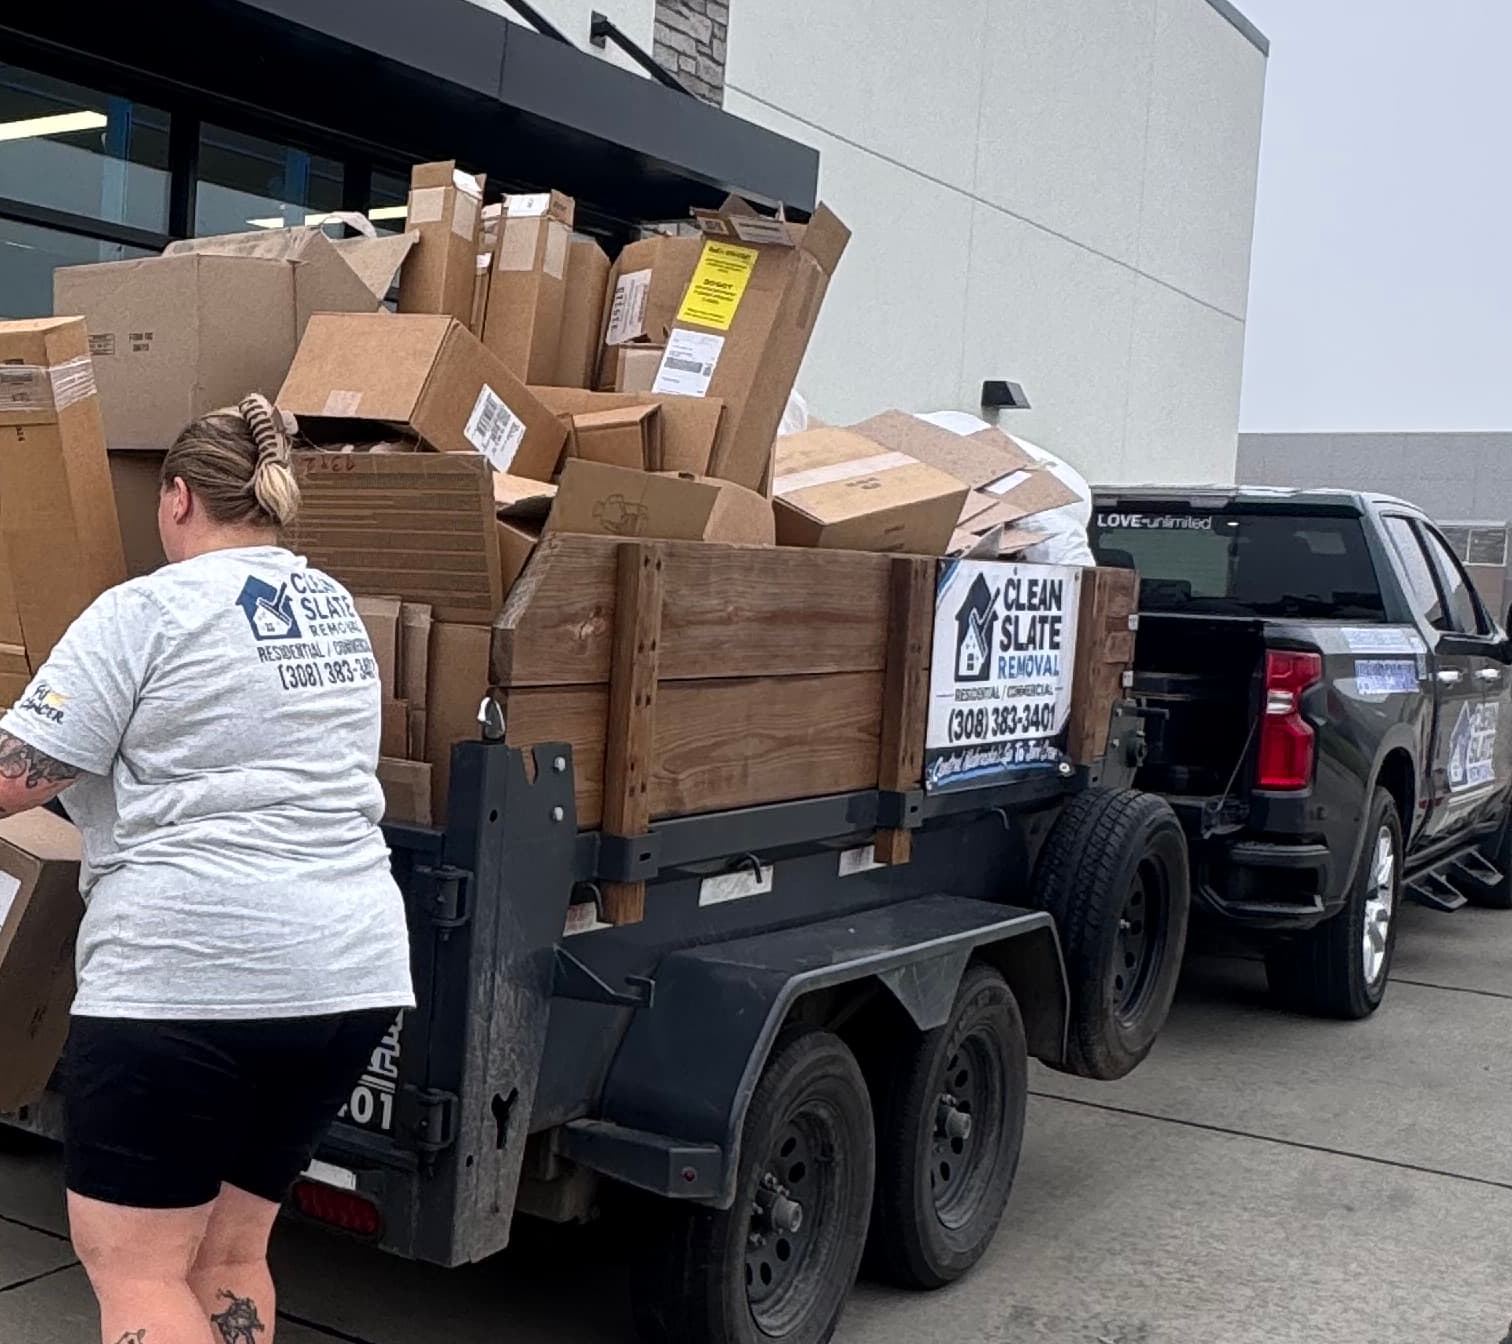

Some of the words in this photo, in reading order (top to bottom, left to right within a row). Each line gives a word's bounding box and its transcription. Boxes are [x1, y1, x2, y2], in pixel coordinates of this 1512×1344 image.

[300, 594, 355, 621] SLATE
[1003, 577, 1064, 612] CLEAN
[999, 613, 1061, 653] SLATE
[277, 661, 324, 691] (308)
[997, 655, 1060, 681] REMOVAL
[948, 707, 989, 744] (308)
[990, 703, 1057, 738] 383-3401
